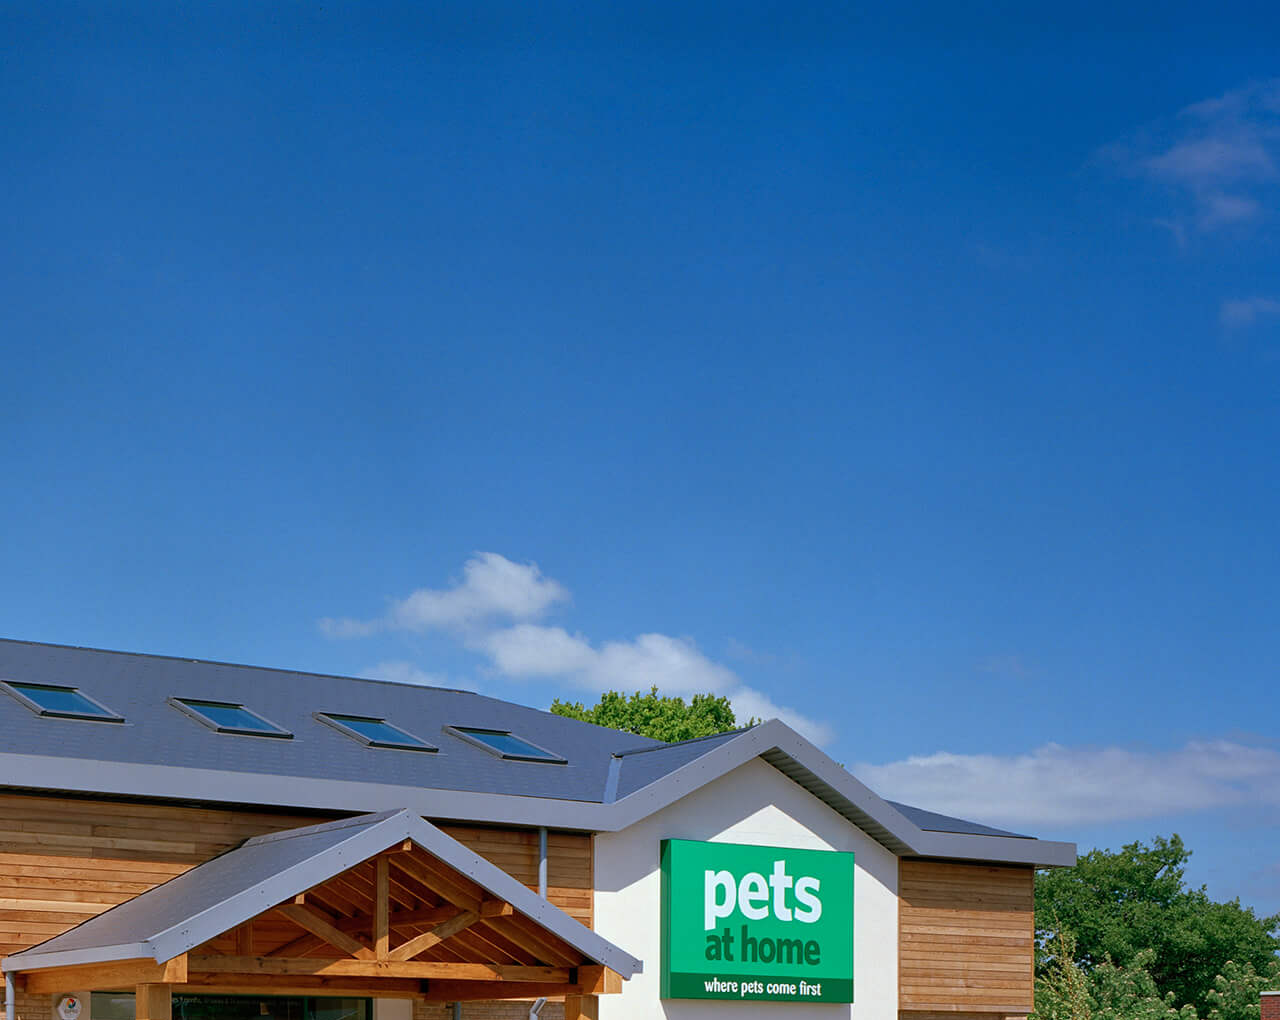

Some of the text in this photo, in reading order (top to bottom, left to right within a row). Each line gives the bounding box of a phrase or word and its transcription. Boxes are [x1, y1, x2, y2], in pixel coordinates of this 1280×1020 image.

[704, 859, 823, 931] pets
[705, 925, 821, 966] at home
[704, 977, 822, 997] where pets come first
